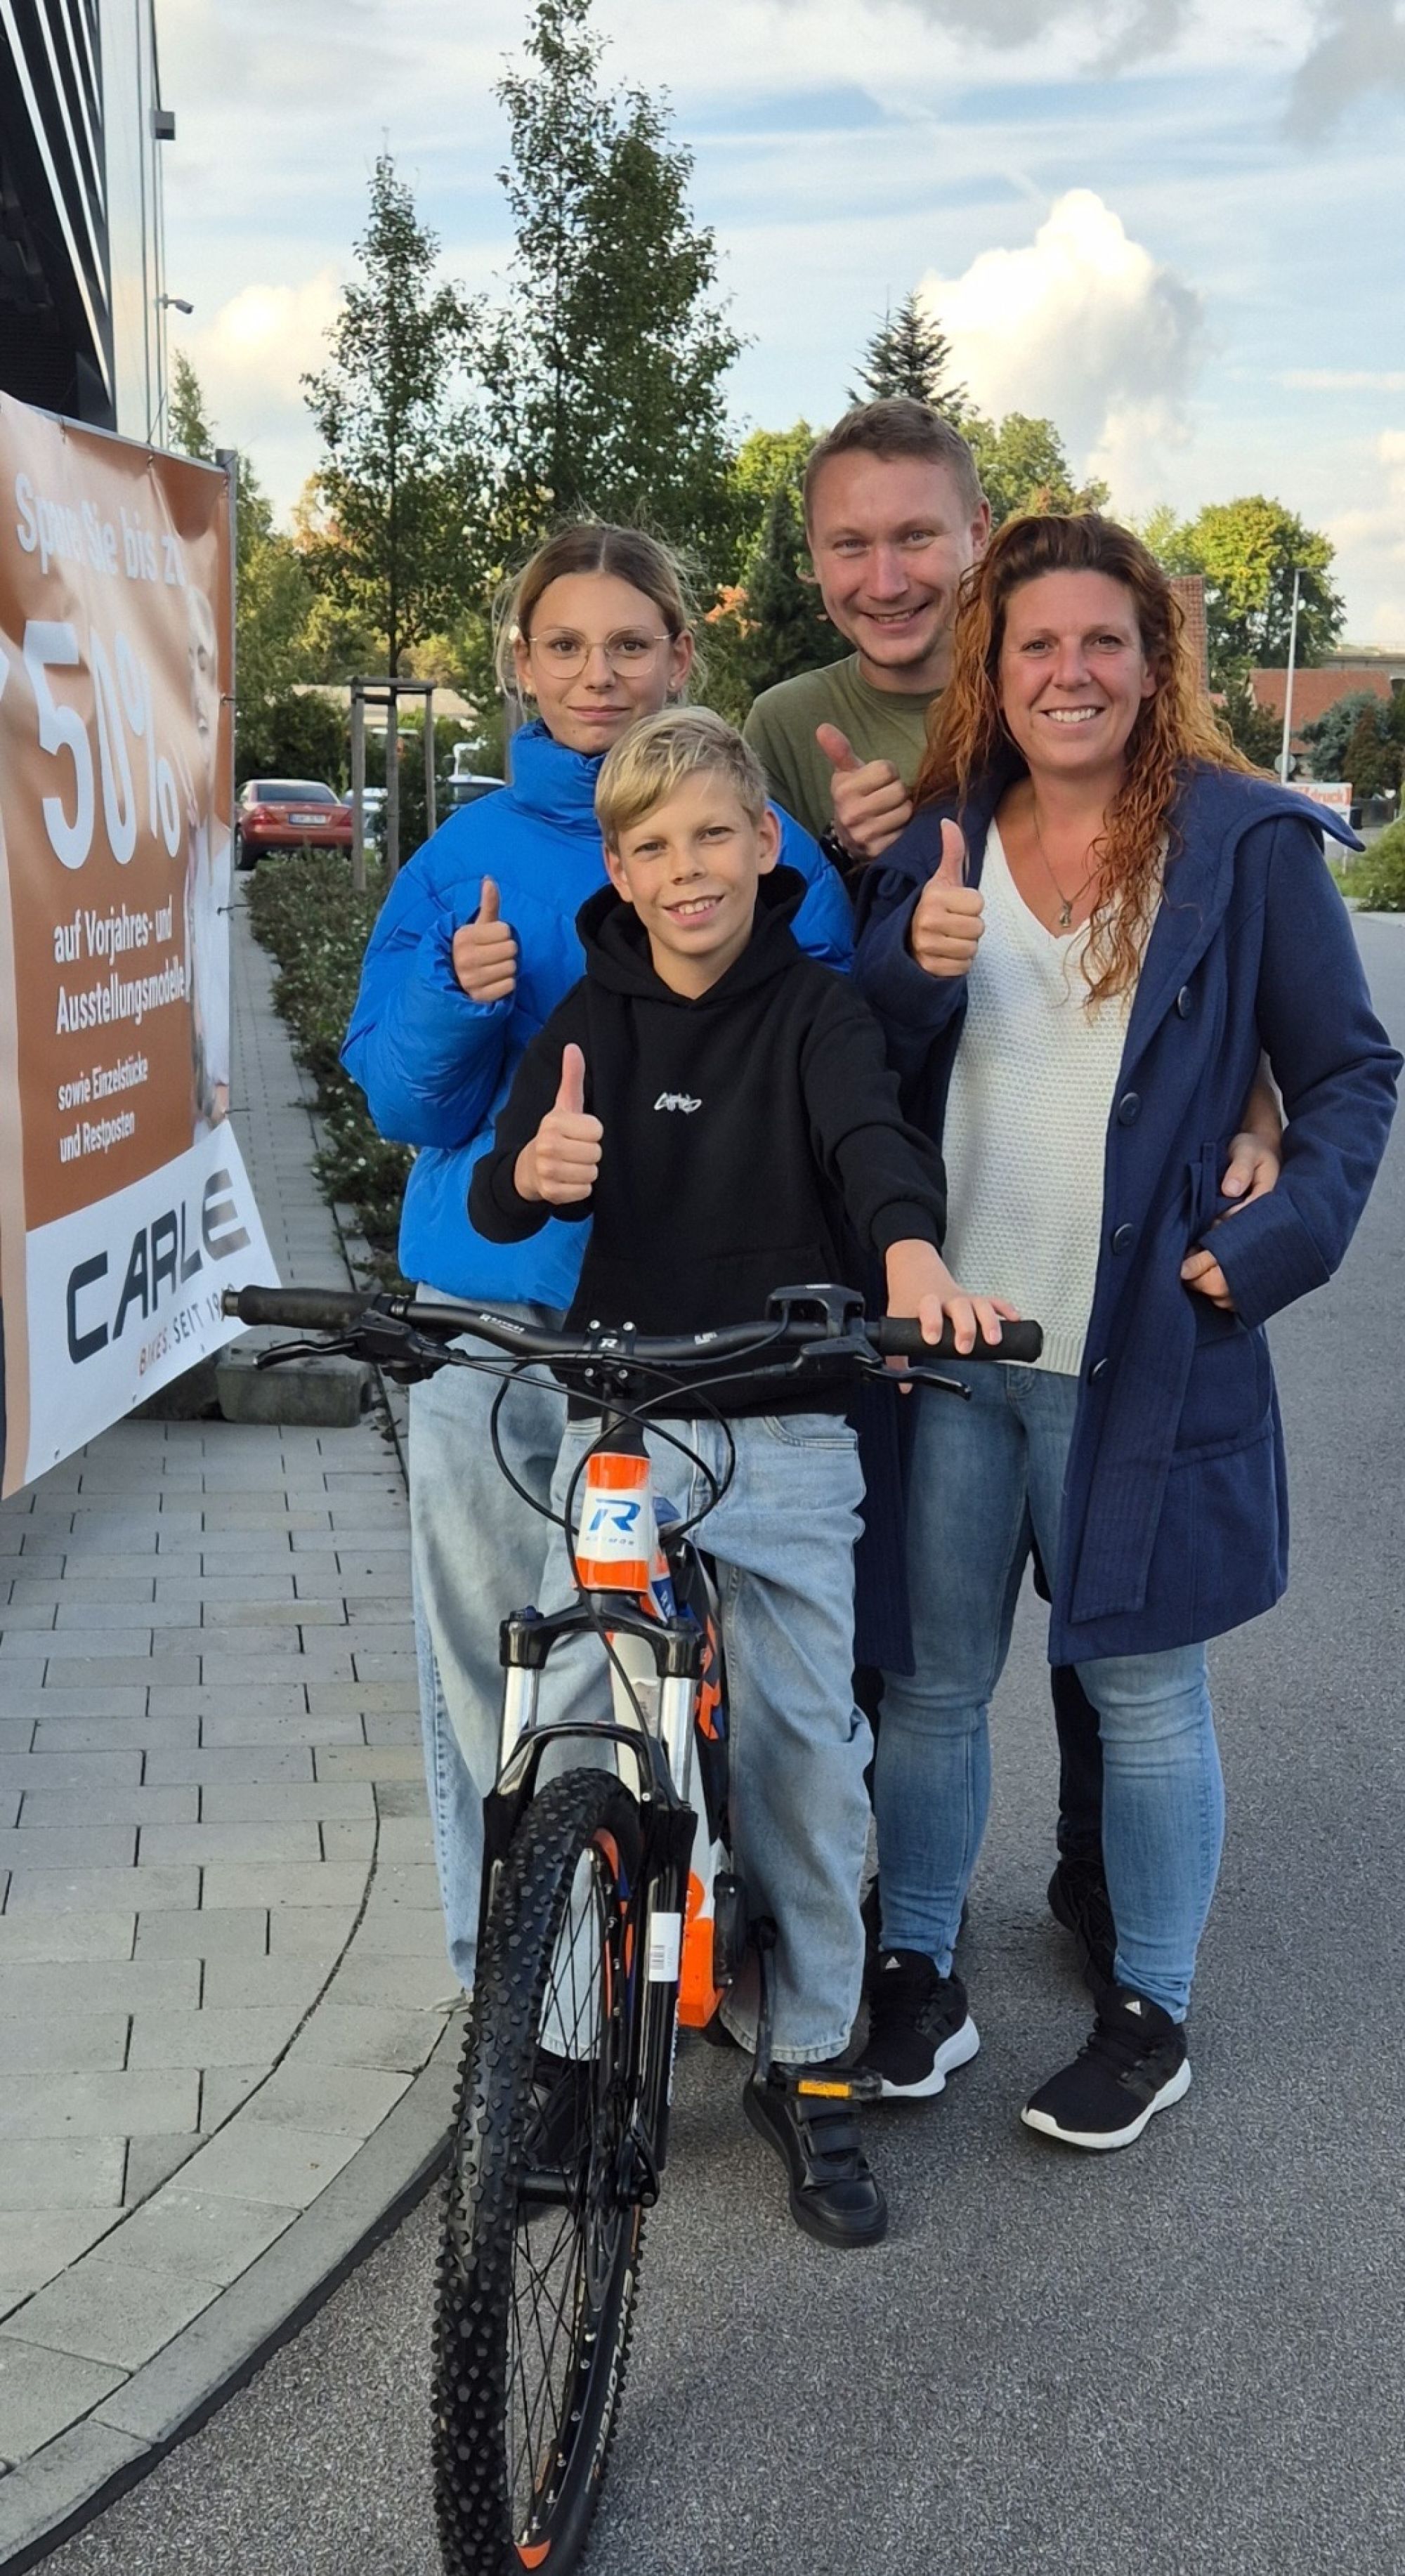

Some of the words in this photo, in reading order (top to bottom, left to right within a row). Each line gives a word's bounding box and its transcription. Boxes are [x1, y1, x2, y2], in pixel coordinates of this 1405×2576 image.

[119, 506, 157, 582] bis
[23, 620, 181, 870] 50%
[54, 909, 81, 963] auf
[84, 903, 152, 966] Vorjahres-
[155, 894, 172, 943] und
[58, 1071, 91, 1111] sowie
[92, 1052, 148, 1100] Einzelstücke
[60, 1124, 81, 1163] und
[82, 1111, 135, 1154] Restposten
[67, 1168, 251, 1364] CARLE
[174, 1302, 204, 1345] SEIT
